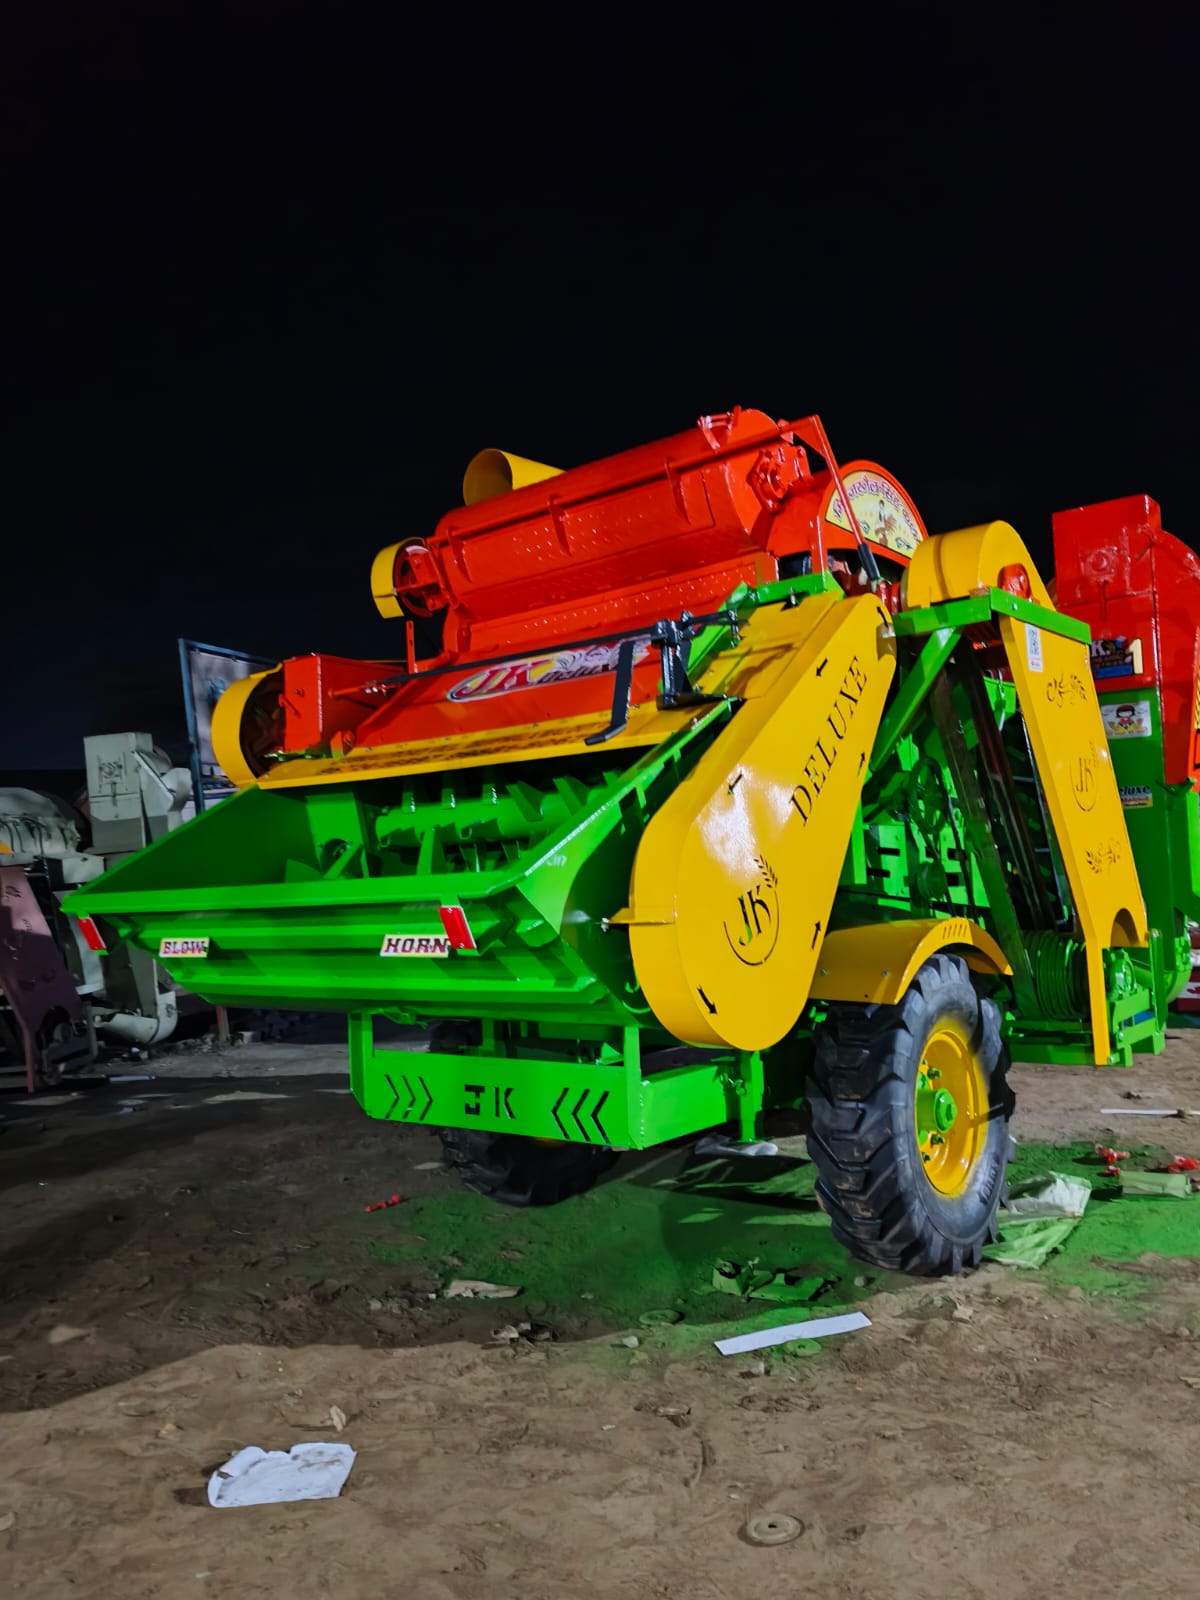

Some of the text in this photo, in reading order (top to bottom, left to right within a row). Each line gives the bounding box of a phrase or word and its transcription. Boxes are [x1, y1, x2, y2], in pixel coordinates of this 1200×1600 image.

[452, 658, 552, 697] JK
[788, 655, 869, 827] DELUXE
[1119, 784, 1152, 796] eluxe
[738, 884, 773, 947] JK
[161, 938, 207, 955] BLOW
[383, 936, 449, 954] HORN
